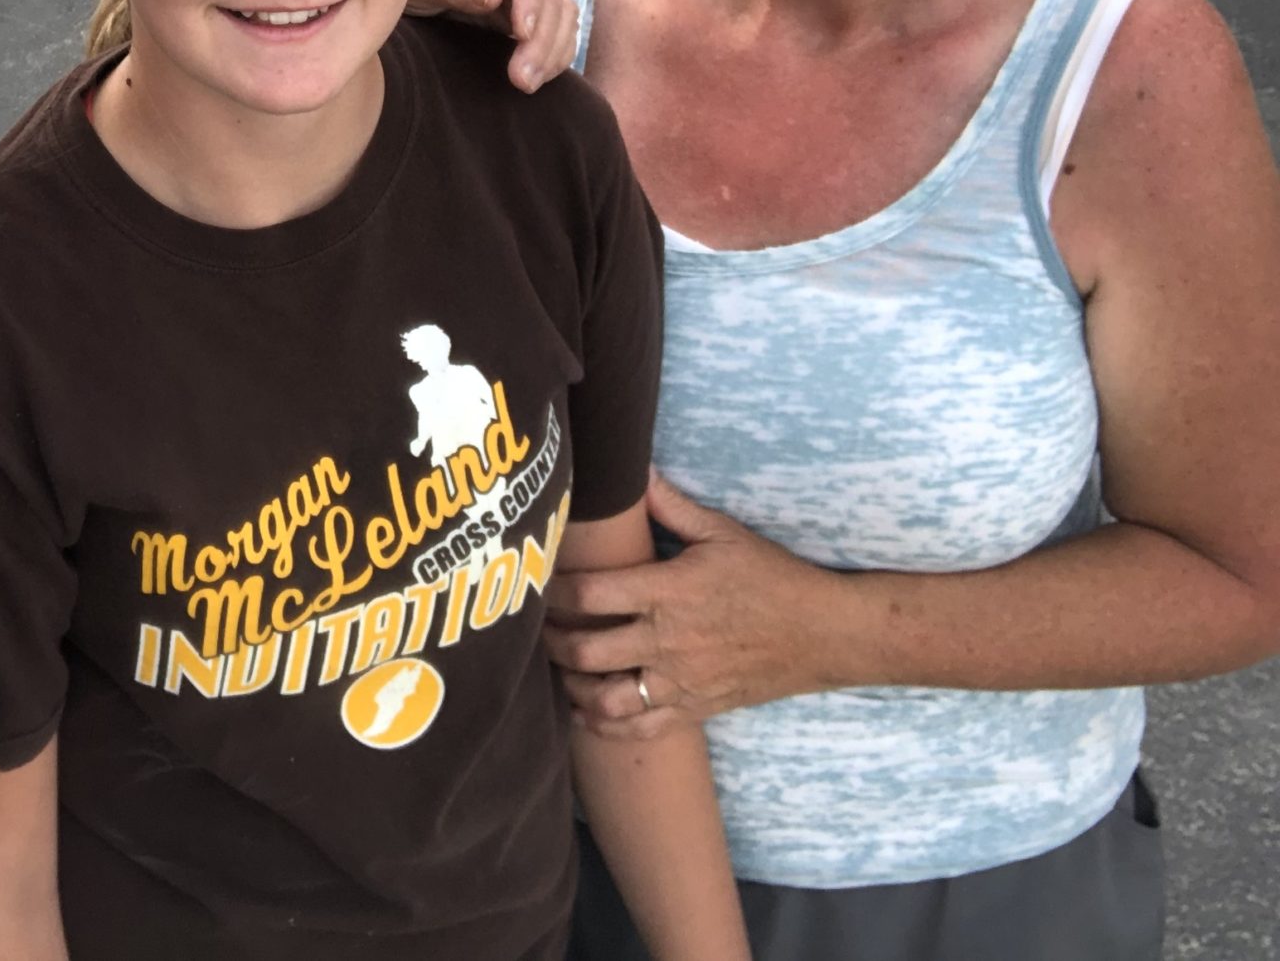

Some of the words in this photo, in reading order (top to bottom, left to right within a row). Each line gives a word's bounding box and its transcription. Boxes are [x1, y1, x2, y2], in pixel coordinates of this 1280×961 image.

[131, 456, 350, 595] Morgan
[187, 380, 530, 660] McLeland
[417, 510, 501, 584] CROSS
[499, 412, 561, 522] COUNT
